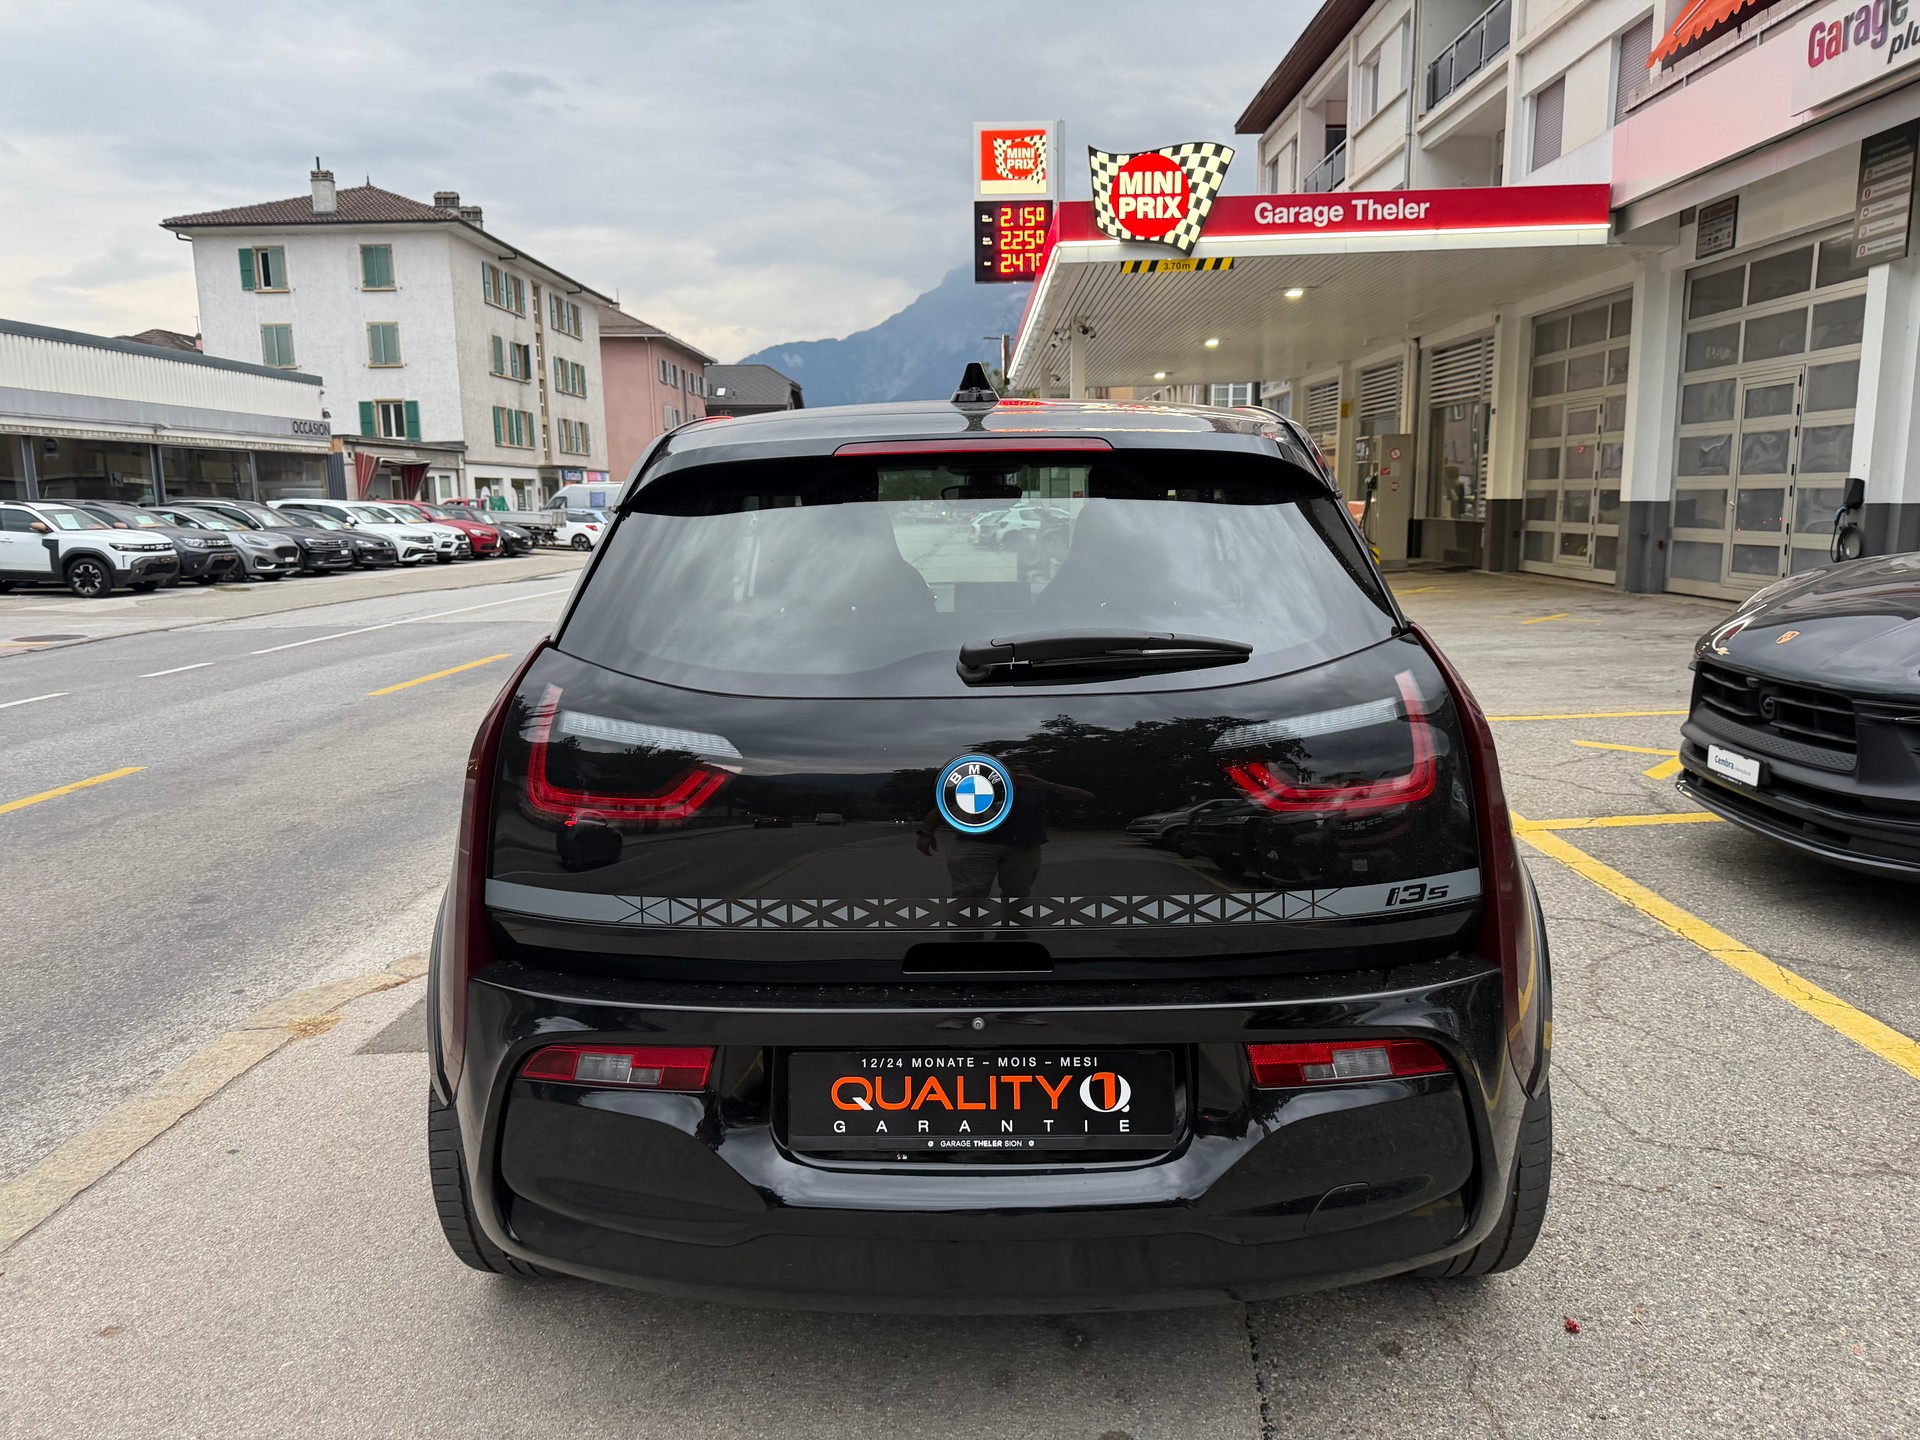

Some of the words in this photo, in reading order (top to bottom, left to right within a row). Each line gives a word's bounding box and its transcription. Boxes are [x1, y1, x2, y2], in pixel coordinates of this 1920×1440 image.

[1808, 0, 1909, 68] Garage
[1006, 147, 1035, 159] MINI
[1006, 158, 1035, 170] PRIX
[1119, 170, 1182, 195] MINI
[1118, 195, 1183, 220] PRIX
[1254, 202, 1344, 228] Garage
[1351, 198, 1431, 221] Theler
[292, 420, 331, 436] OCCASION
[949, 764, 1001, 785] BMW
[1385, 883, 1450, 907] i3s
[861, 1057, 904, 1069] 12/24
[911, 1057, 975, 1068] MONATE
[998, 1056, 1037, 1068] MOIS
[1060, 1056, 1099, 1067] MESI
[830, 1075, 1073, 1111] QUALITY
[833, 1119, 1130, 1133] GARANTIE
[940, 1140, 971, 1148] GARAGE
[973, 1140, 1002, 1148] THELER
[1004, 1140, 1023, 1148] SION
